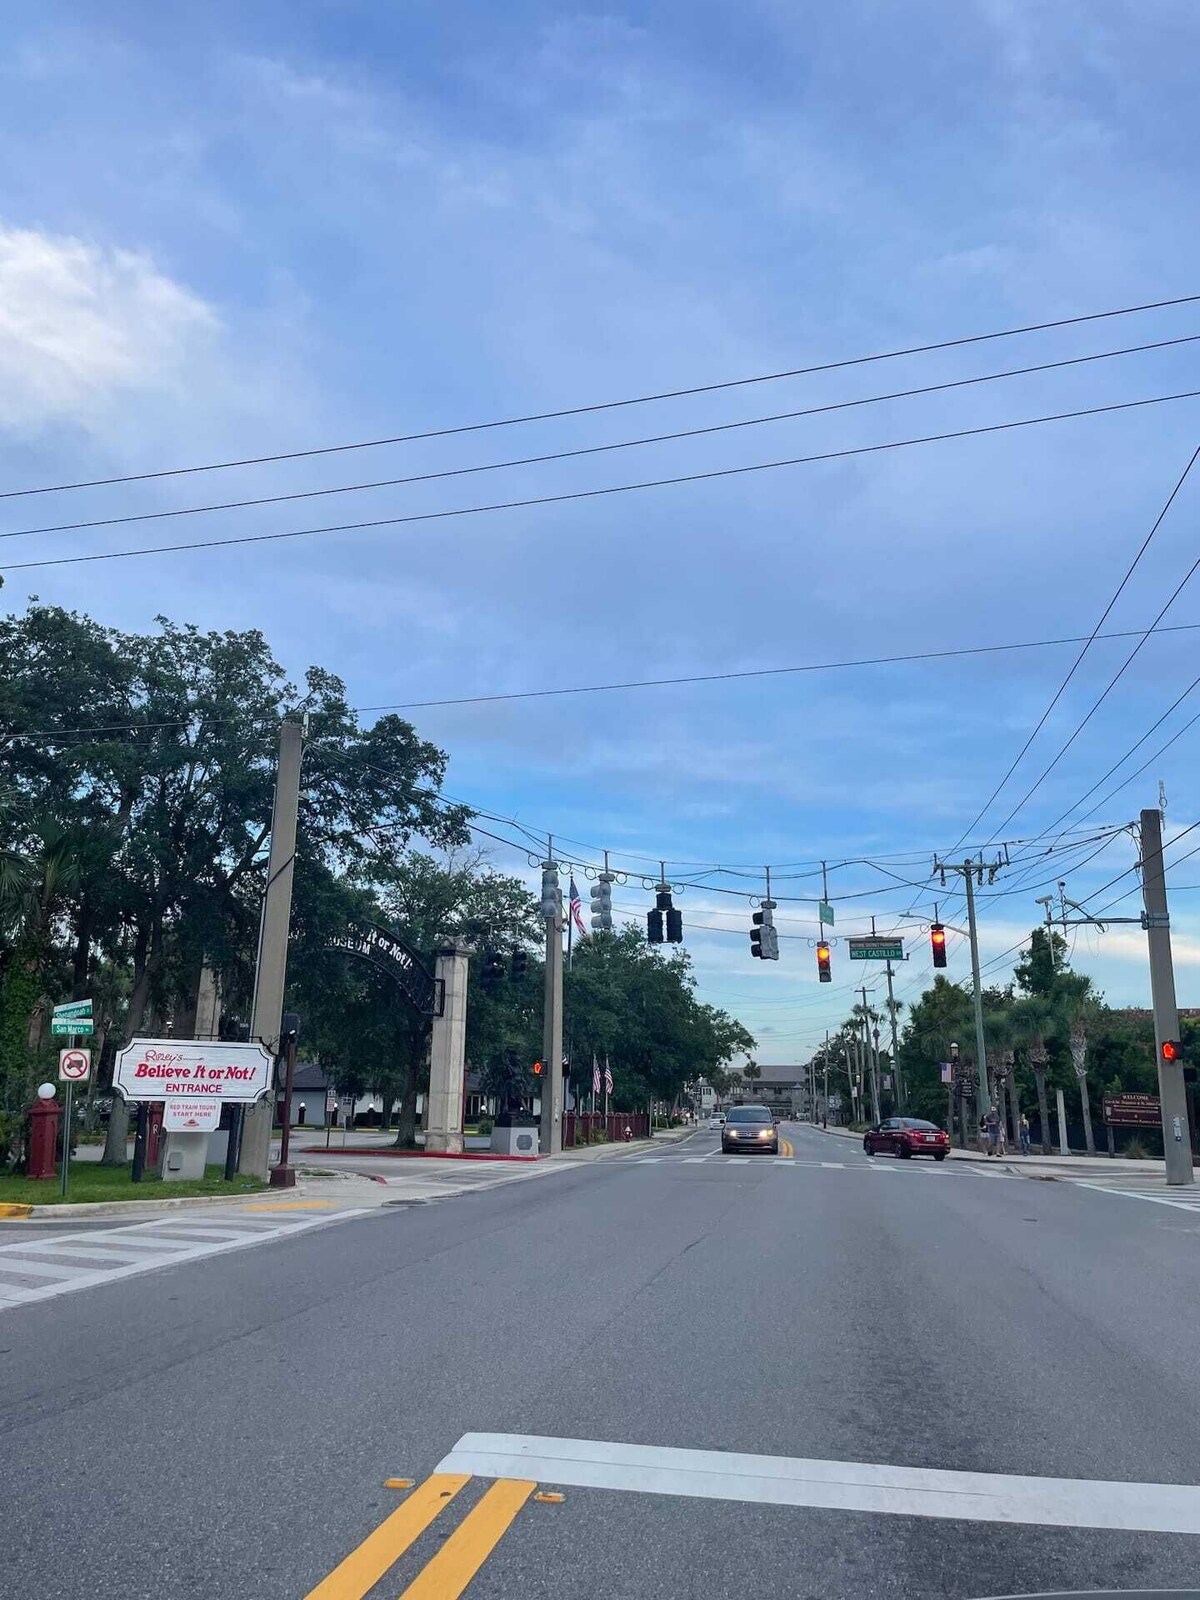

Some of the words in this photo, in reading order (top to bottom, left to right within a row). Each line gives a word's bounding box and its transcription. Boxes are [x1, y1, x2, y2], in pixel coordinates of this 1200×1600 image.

[378, 937, 390, 951] or
[851, 949, 866, 957] WEST
[868, 949, 896, 957] CASTILLO
[56, 1024, 67, 1033] San
[67, 1025, 85, 1033] Marco
[135, 1063, 191, 1078] Believe
[193, 1065, 206, 1078] It
[208, 1068, 225, 1079] or
[224, 1066, 256, 1080] Not!
[165, 1083, 223, 1093] ENTRANCE
